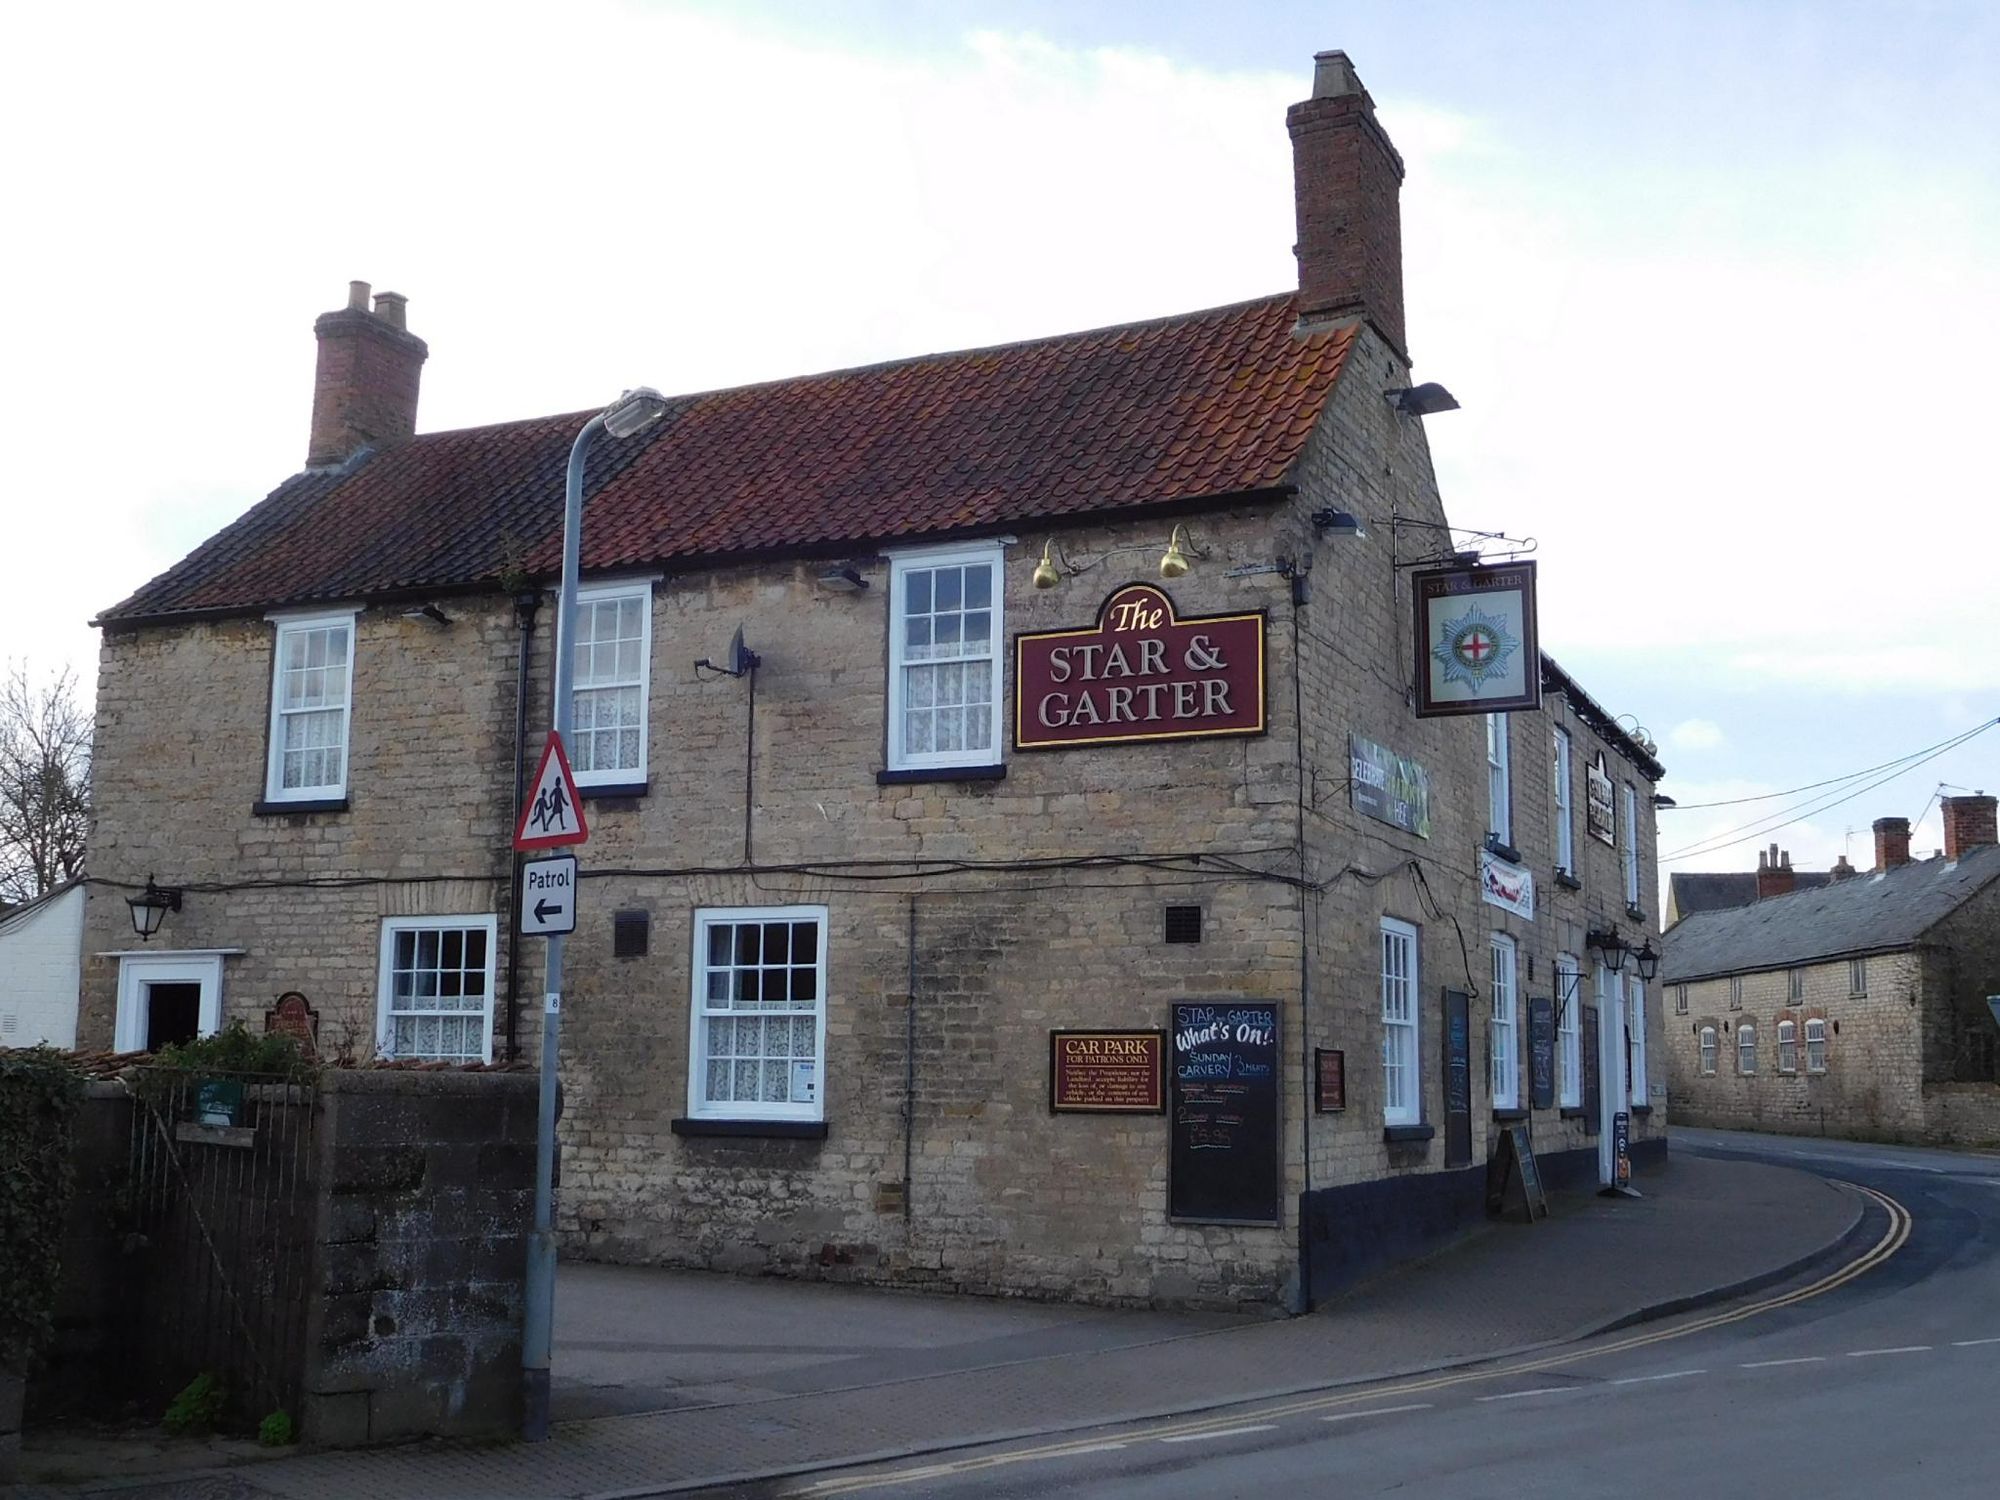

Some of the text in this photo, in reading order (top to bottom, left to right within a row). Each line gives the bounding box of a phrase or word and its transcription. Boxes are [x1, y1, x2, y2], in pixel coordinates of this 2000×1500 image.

[1428, 575, 1523, 594] STAR & GARTER
[1110, 598, 1163, 632] The
[1050, 635, 1228, 683] STAR &
[1038, 679, 1235, 728] GARTER
[529, 868, 570, 890] Patrol
[1178, 1007, 1273, 1024] STAR GARTER
[1176, 1022, 1229, 1051] What's
[1066, 1040, 1149, 1054] CAR PARK
[1066, 1055, 1149, 1064] FOR PATRONS ONLY
[1190, 1051, 1232, 1064] SUNDAY
[1178, 1063, 1231, 1078] CARVERY
